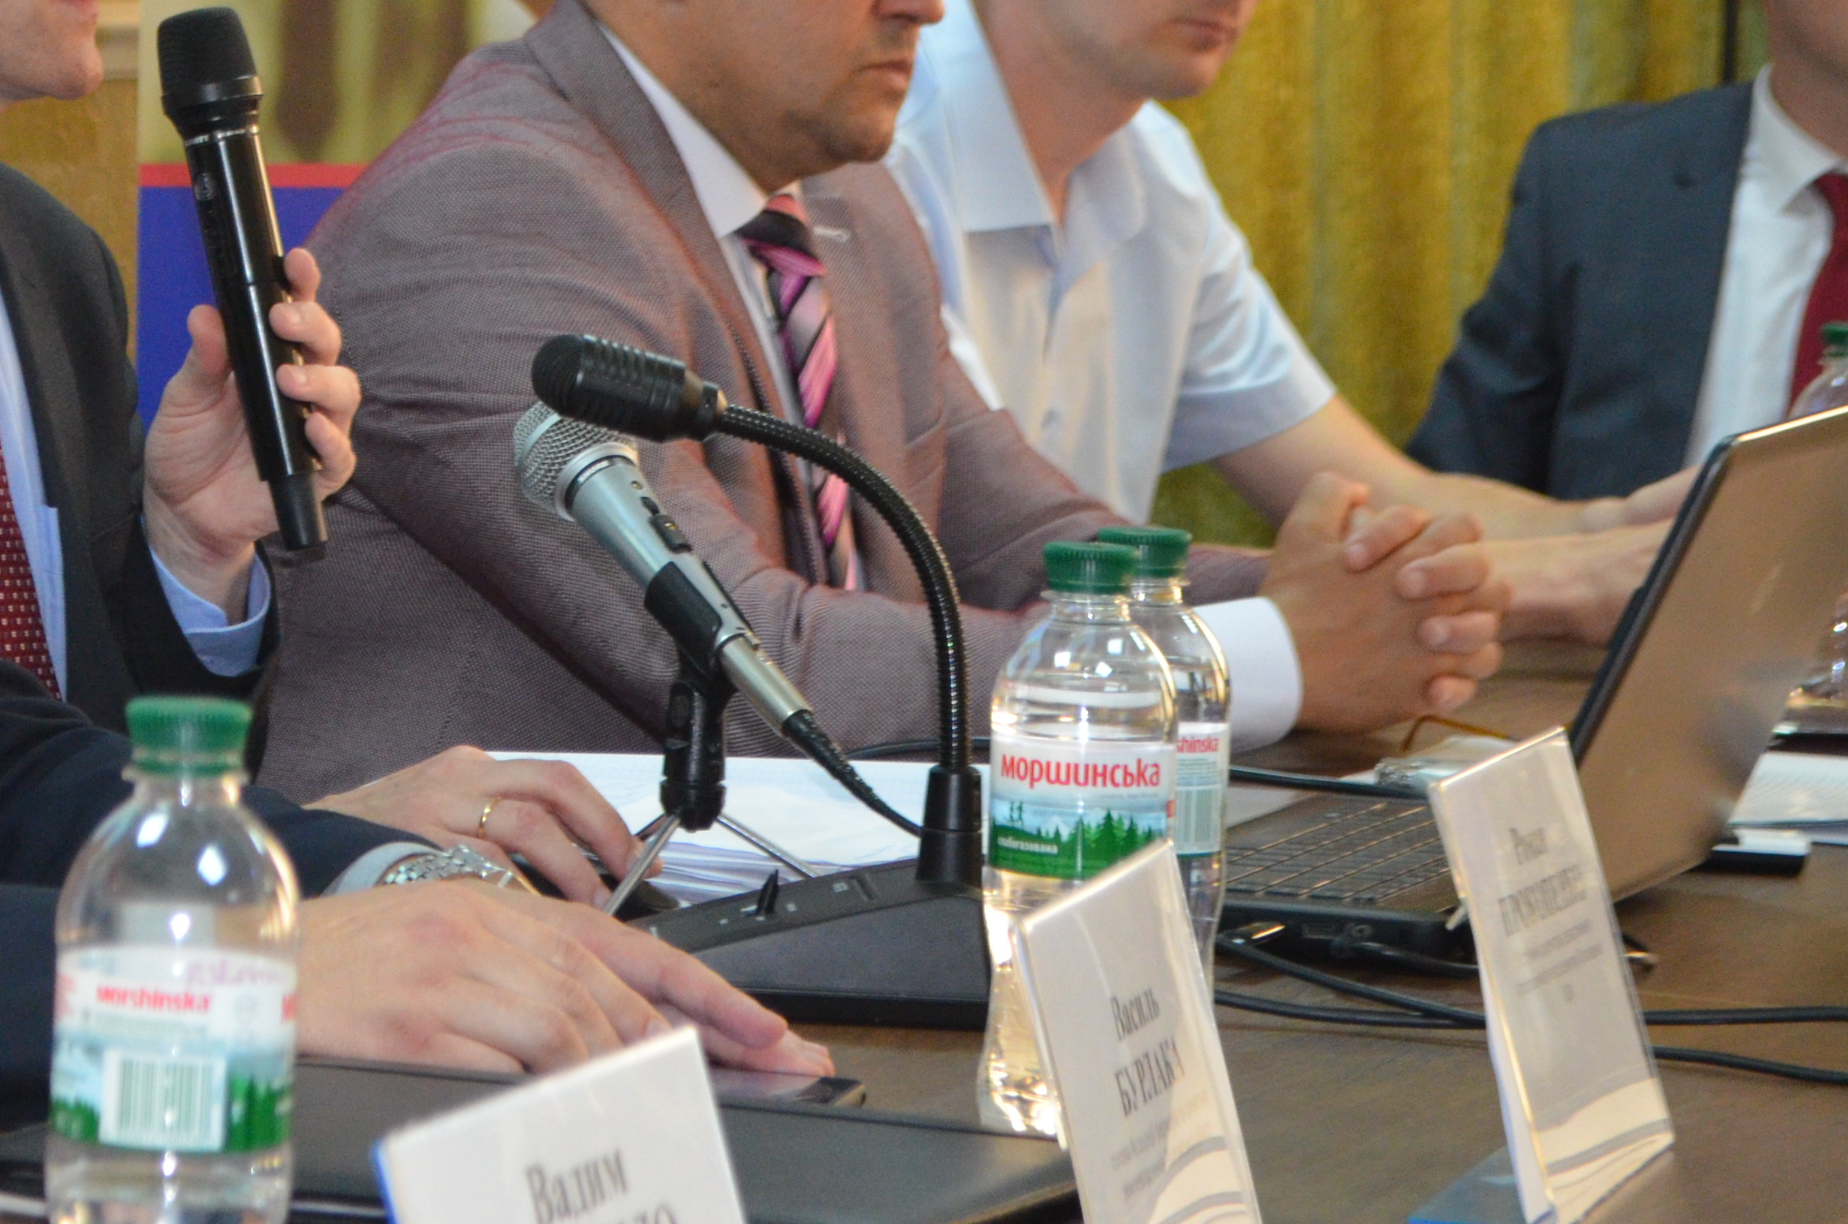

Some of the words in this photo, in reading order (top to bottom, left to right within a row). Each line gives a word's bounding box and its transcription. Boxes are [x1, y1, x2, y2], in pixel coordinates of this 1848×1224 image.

[1000, 753, 1162, 789] моршинська
[1109, 987, 1161, 1043] Василь
[526, 1149, 629, 1224] Вадим
